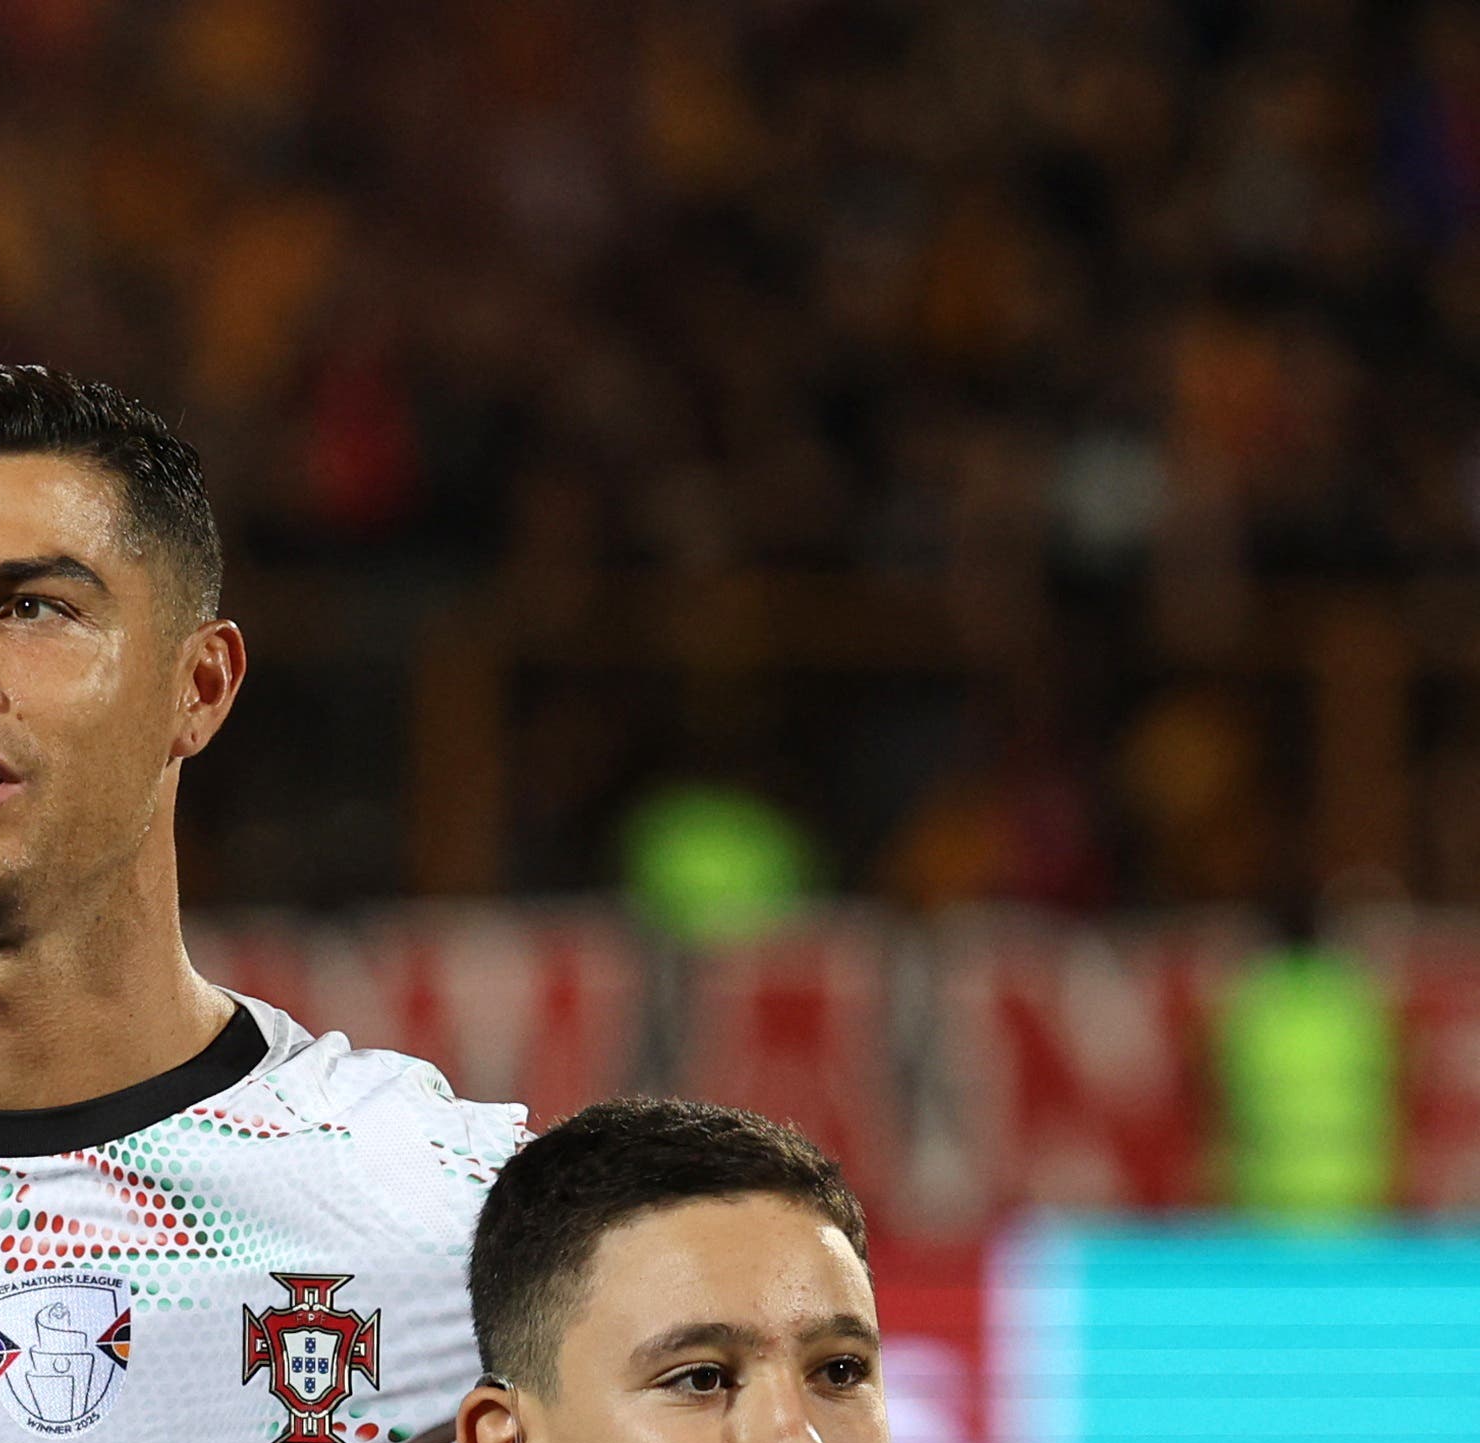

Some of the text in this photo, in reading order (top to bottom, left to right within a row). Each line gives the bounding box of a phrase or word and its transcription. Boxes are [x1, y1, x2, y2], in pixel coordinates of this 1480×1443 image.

[21, 1274, 73, 1289] NATIONS
[76, 1275, 123, 1288] LEAGUE
[26, 1412, 100, 1434] WINNER 2025
